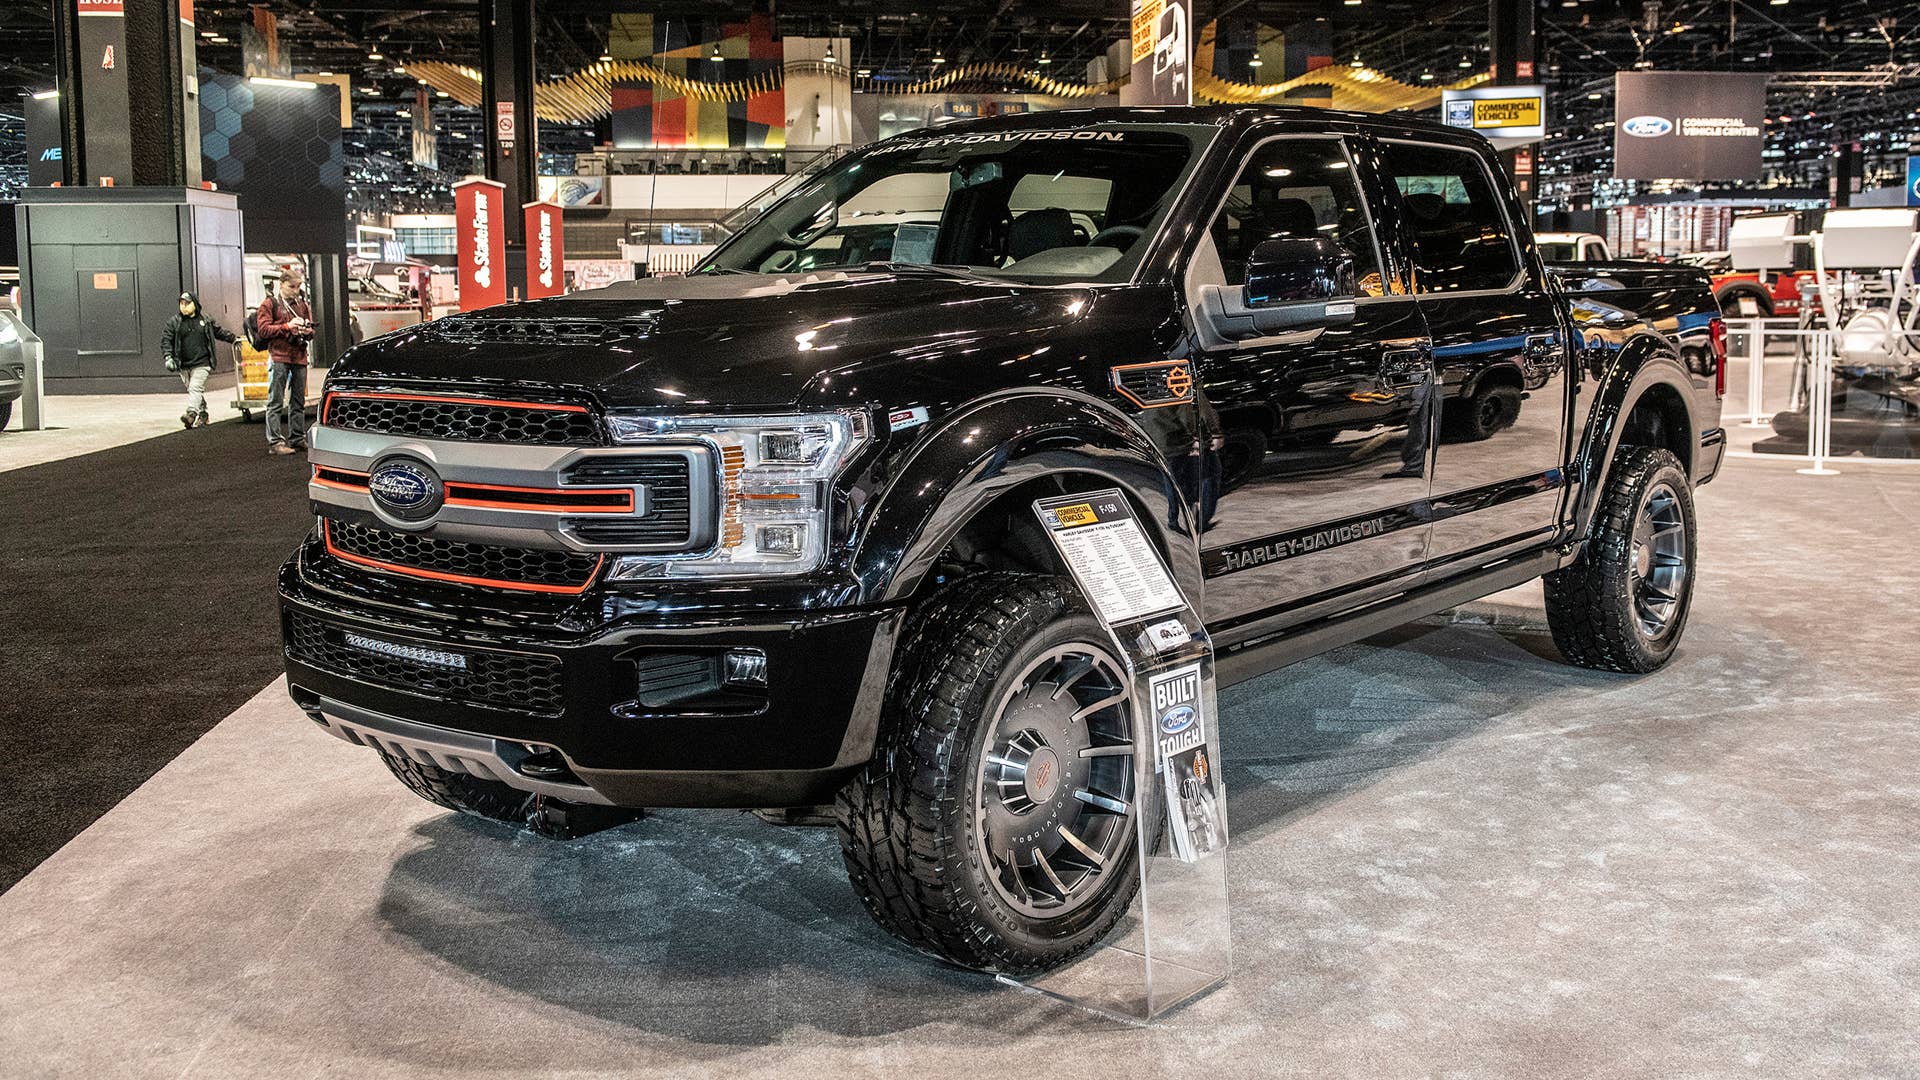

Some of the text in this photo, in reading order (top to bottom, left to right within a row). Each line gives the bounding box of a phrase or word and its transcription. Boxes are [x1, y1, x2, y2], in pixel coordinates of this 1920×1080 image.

[952, 104, 973, 113] BAR
[1003, 104, 1023, 113] BAR
[1477, 102, 1536, 112] COMMERCIAL
[1478, 111, 1519, 121] VEHICLES
[1682, 118, 1746, 127] COMMERCIAL
[1682, 127, 1760, 136] VEHICLE CENTER
[1057, 505, 1091, 516] COMMERCIAL
[1098, 503, 1118, 514] F-150
[1060, 513, 1086, 523] VEHICLES
[1226, 518, 1384, 571] HARLEY-DAVIDSON
[1155, 674, 1196, 710] BUILT
[1160, 728, 1200, 753] TOUGH
